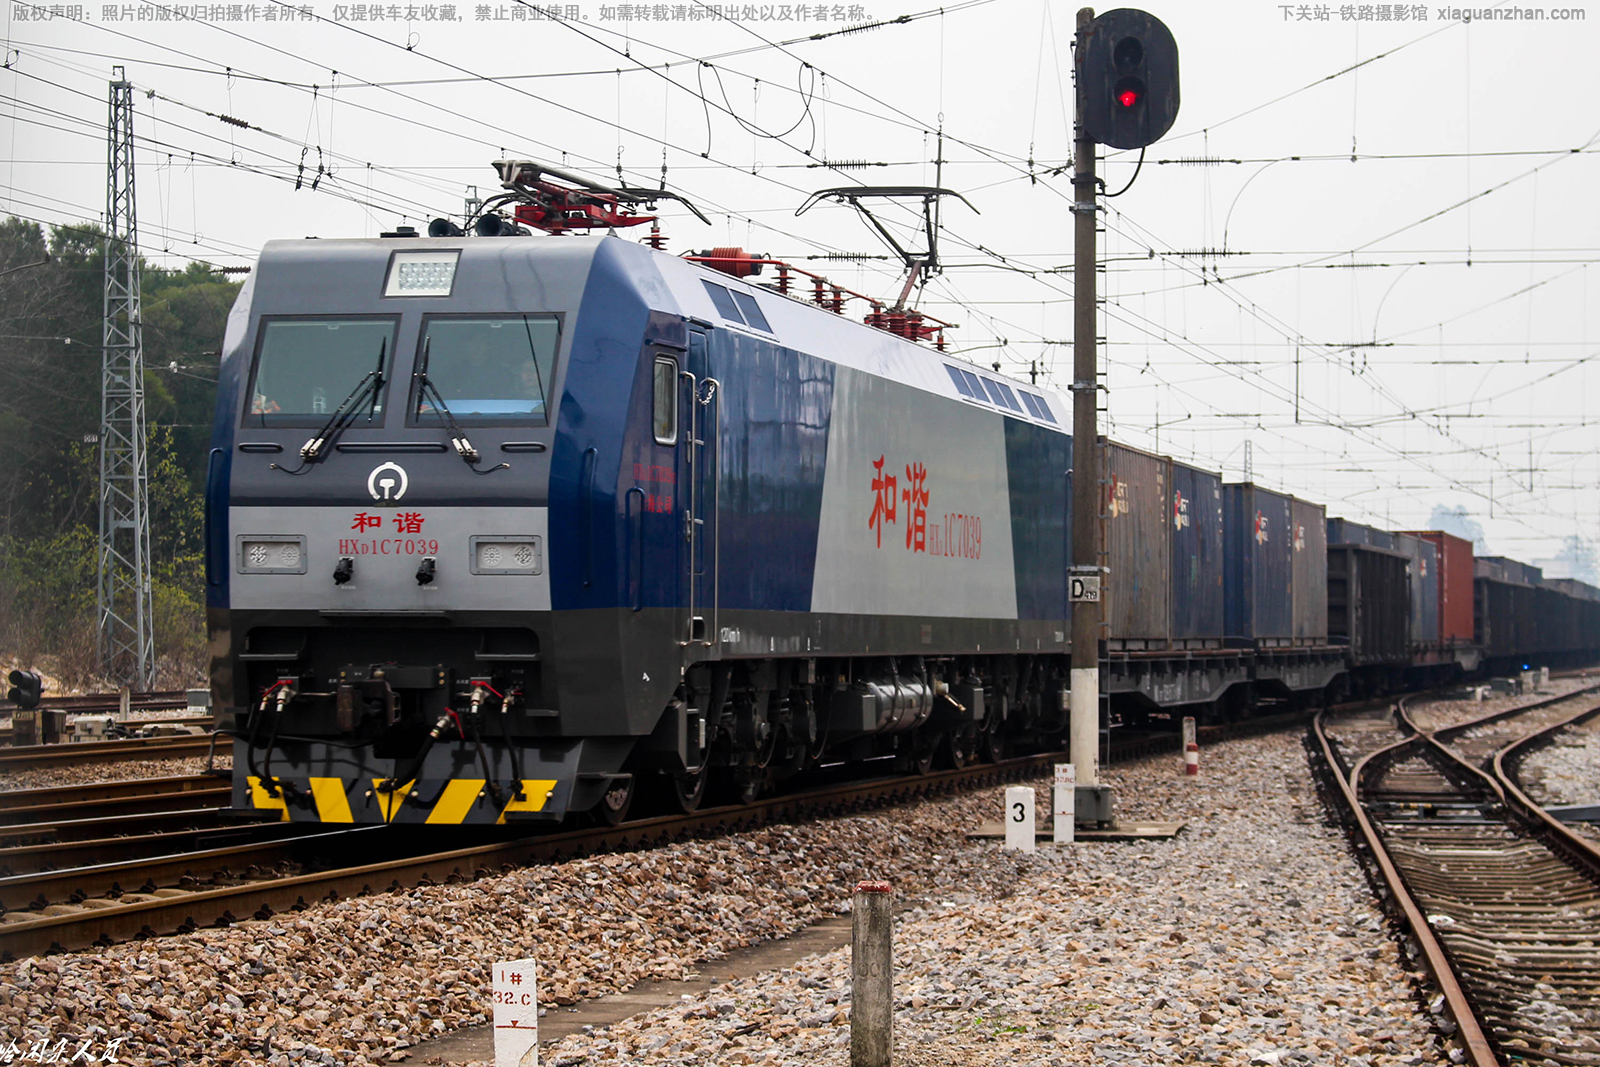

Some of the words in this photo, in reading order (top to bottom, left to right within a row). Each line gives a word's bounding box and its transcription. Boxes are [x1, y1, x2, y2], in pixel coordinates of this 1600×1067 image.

[868, 454, 930, 553] 和谐
[351, 512, 425, 533] 和谐
[1013, 802, 1025, 822] 3
